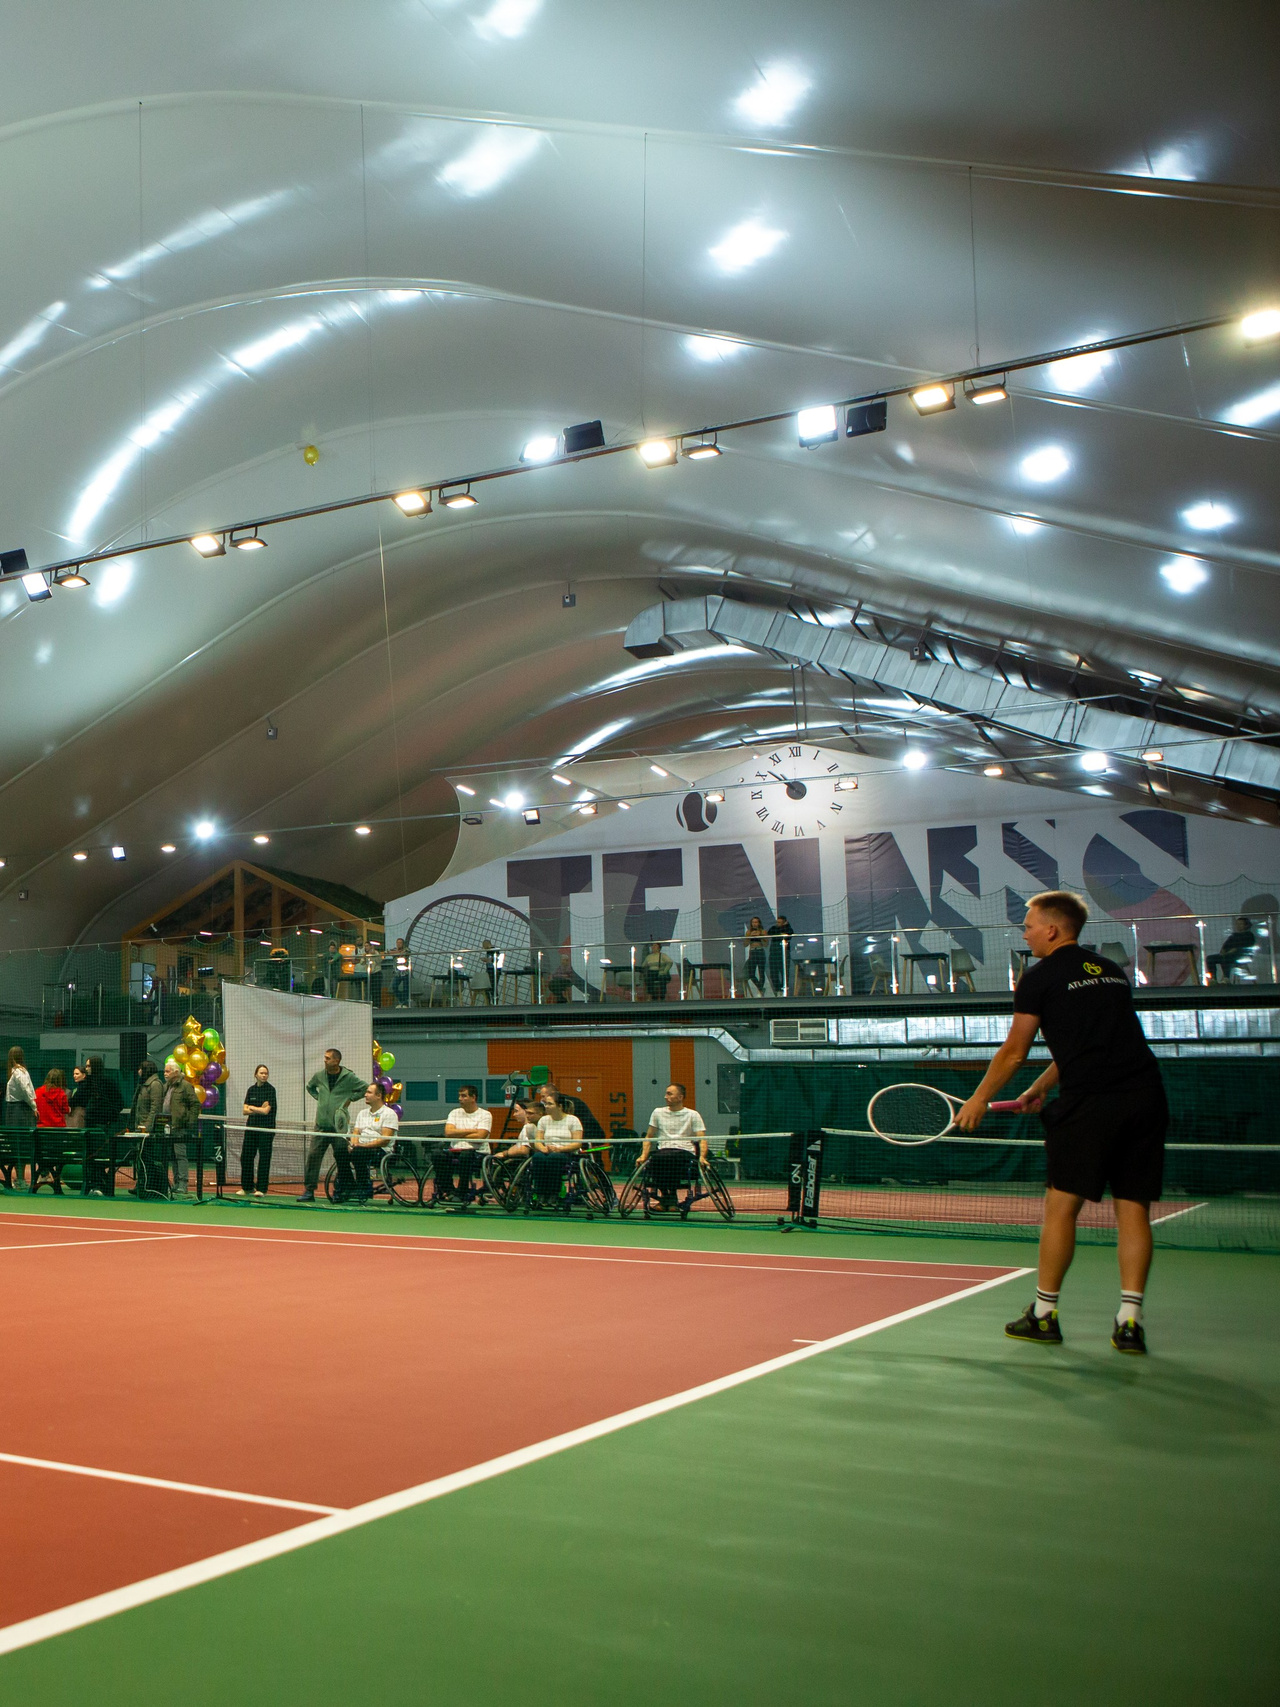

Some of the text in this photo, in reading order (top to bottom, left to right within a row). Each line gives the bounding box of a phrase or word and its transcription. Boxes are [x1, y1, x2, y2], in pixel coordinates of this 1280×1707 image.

[789, 746, 801, 757] XII
[768, 753, 782, 766] XI
[827, 763, 839, 772] II
[755, 771, 767, 781] X
[751, 790, 762, 800] IX
[1068, 978, 1099, 990] ATLANT
[804, 1155, 818, 1208] Babolat
